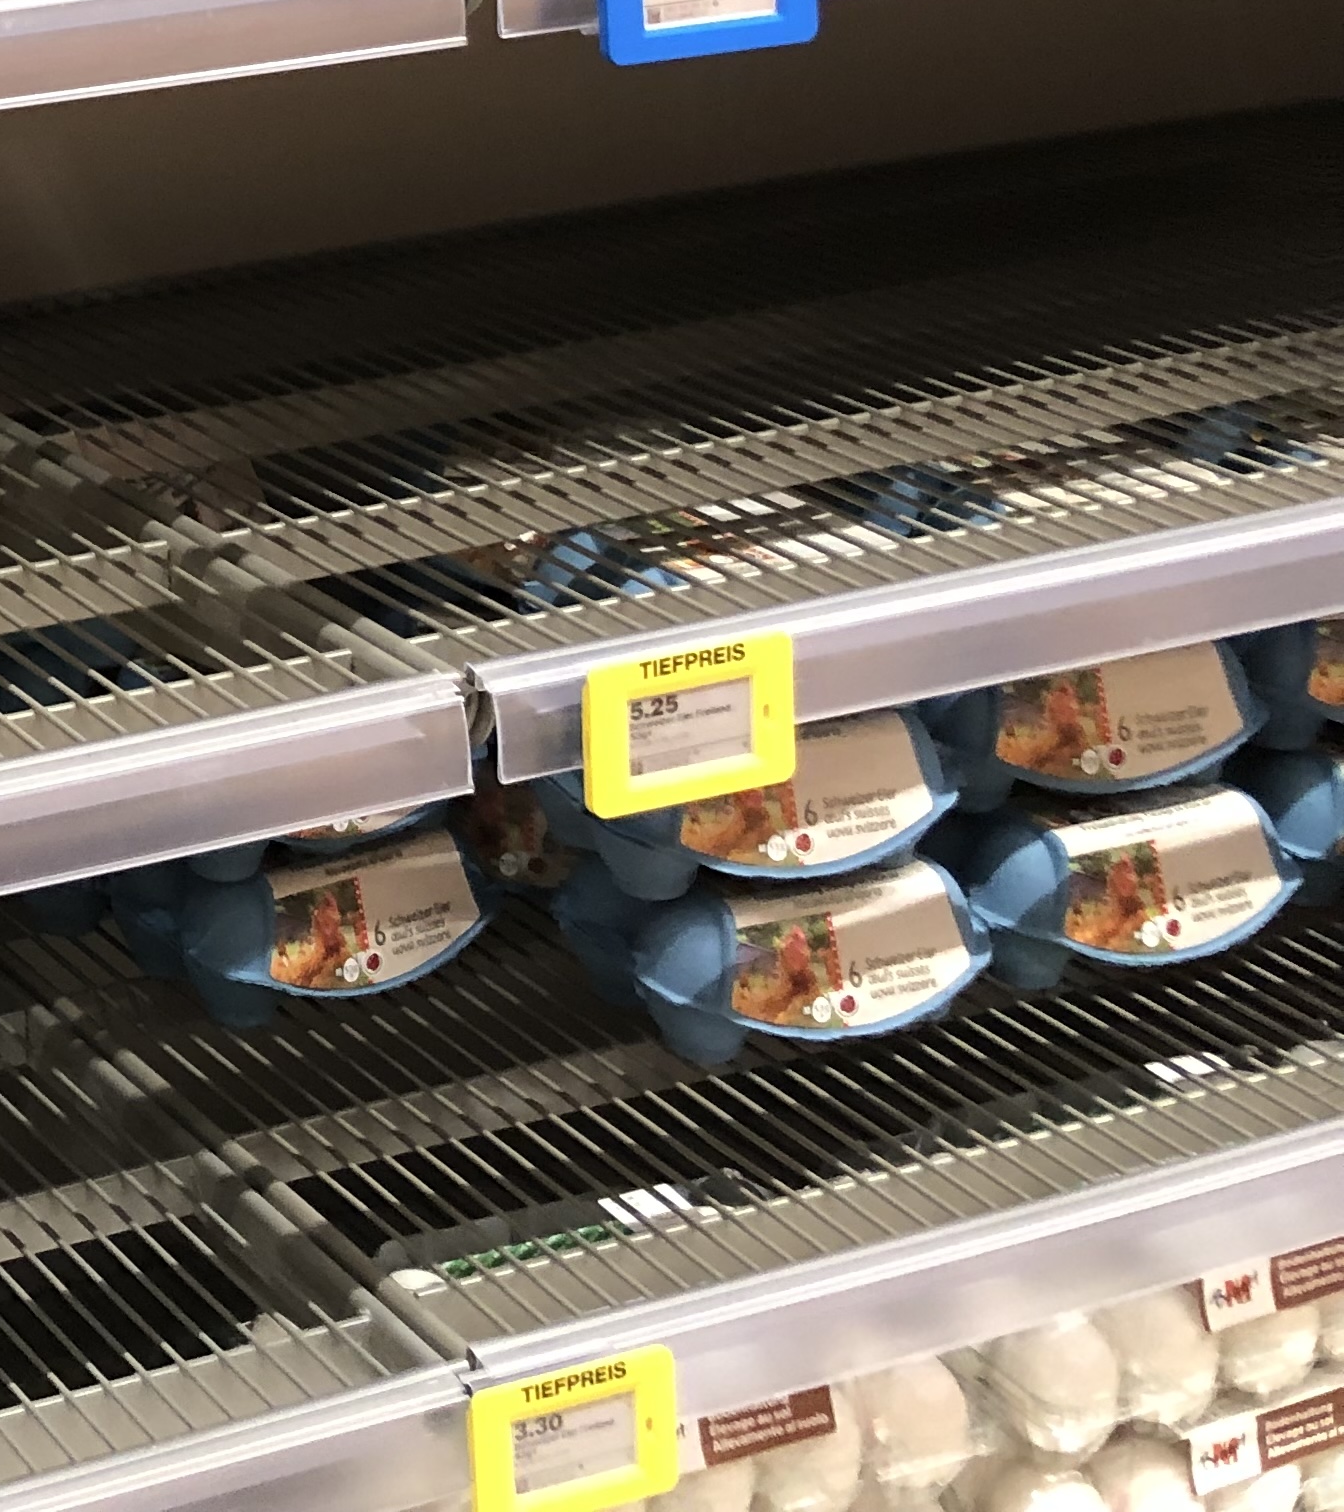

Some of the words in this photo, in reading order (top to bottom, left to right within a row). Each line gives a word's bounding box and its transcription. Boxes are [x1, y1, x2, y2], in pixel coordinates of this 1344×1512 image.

[639, 643, 746, 679] TIEFPREIS
[630, 694, 679, 721] 5.25
[1118, 716, 1131, 742] 6
[804, 799, 818, 827] 6
[374, 919, 386, 946] 6
[848, 961, 863, 988] 6
[521, 1361, 627, 1403] TIEFPREIS
[513, 1414, 563, 1441] 3.30
